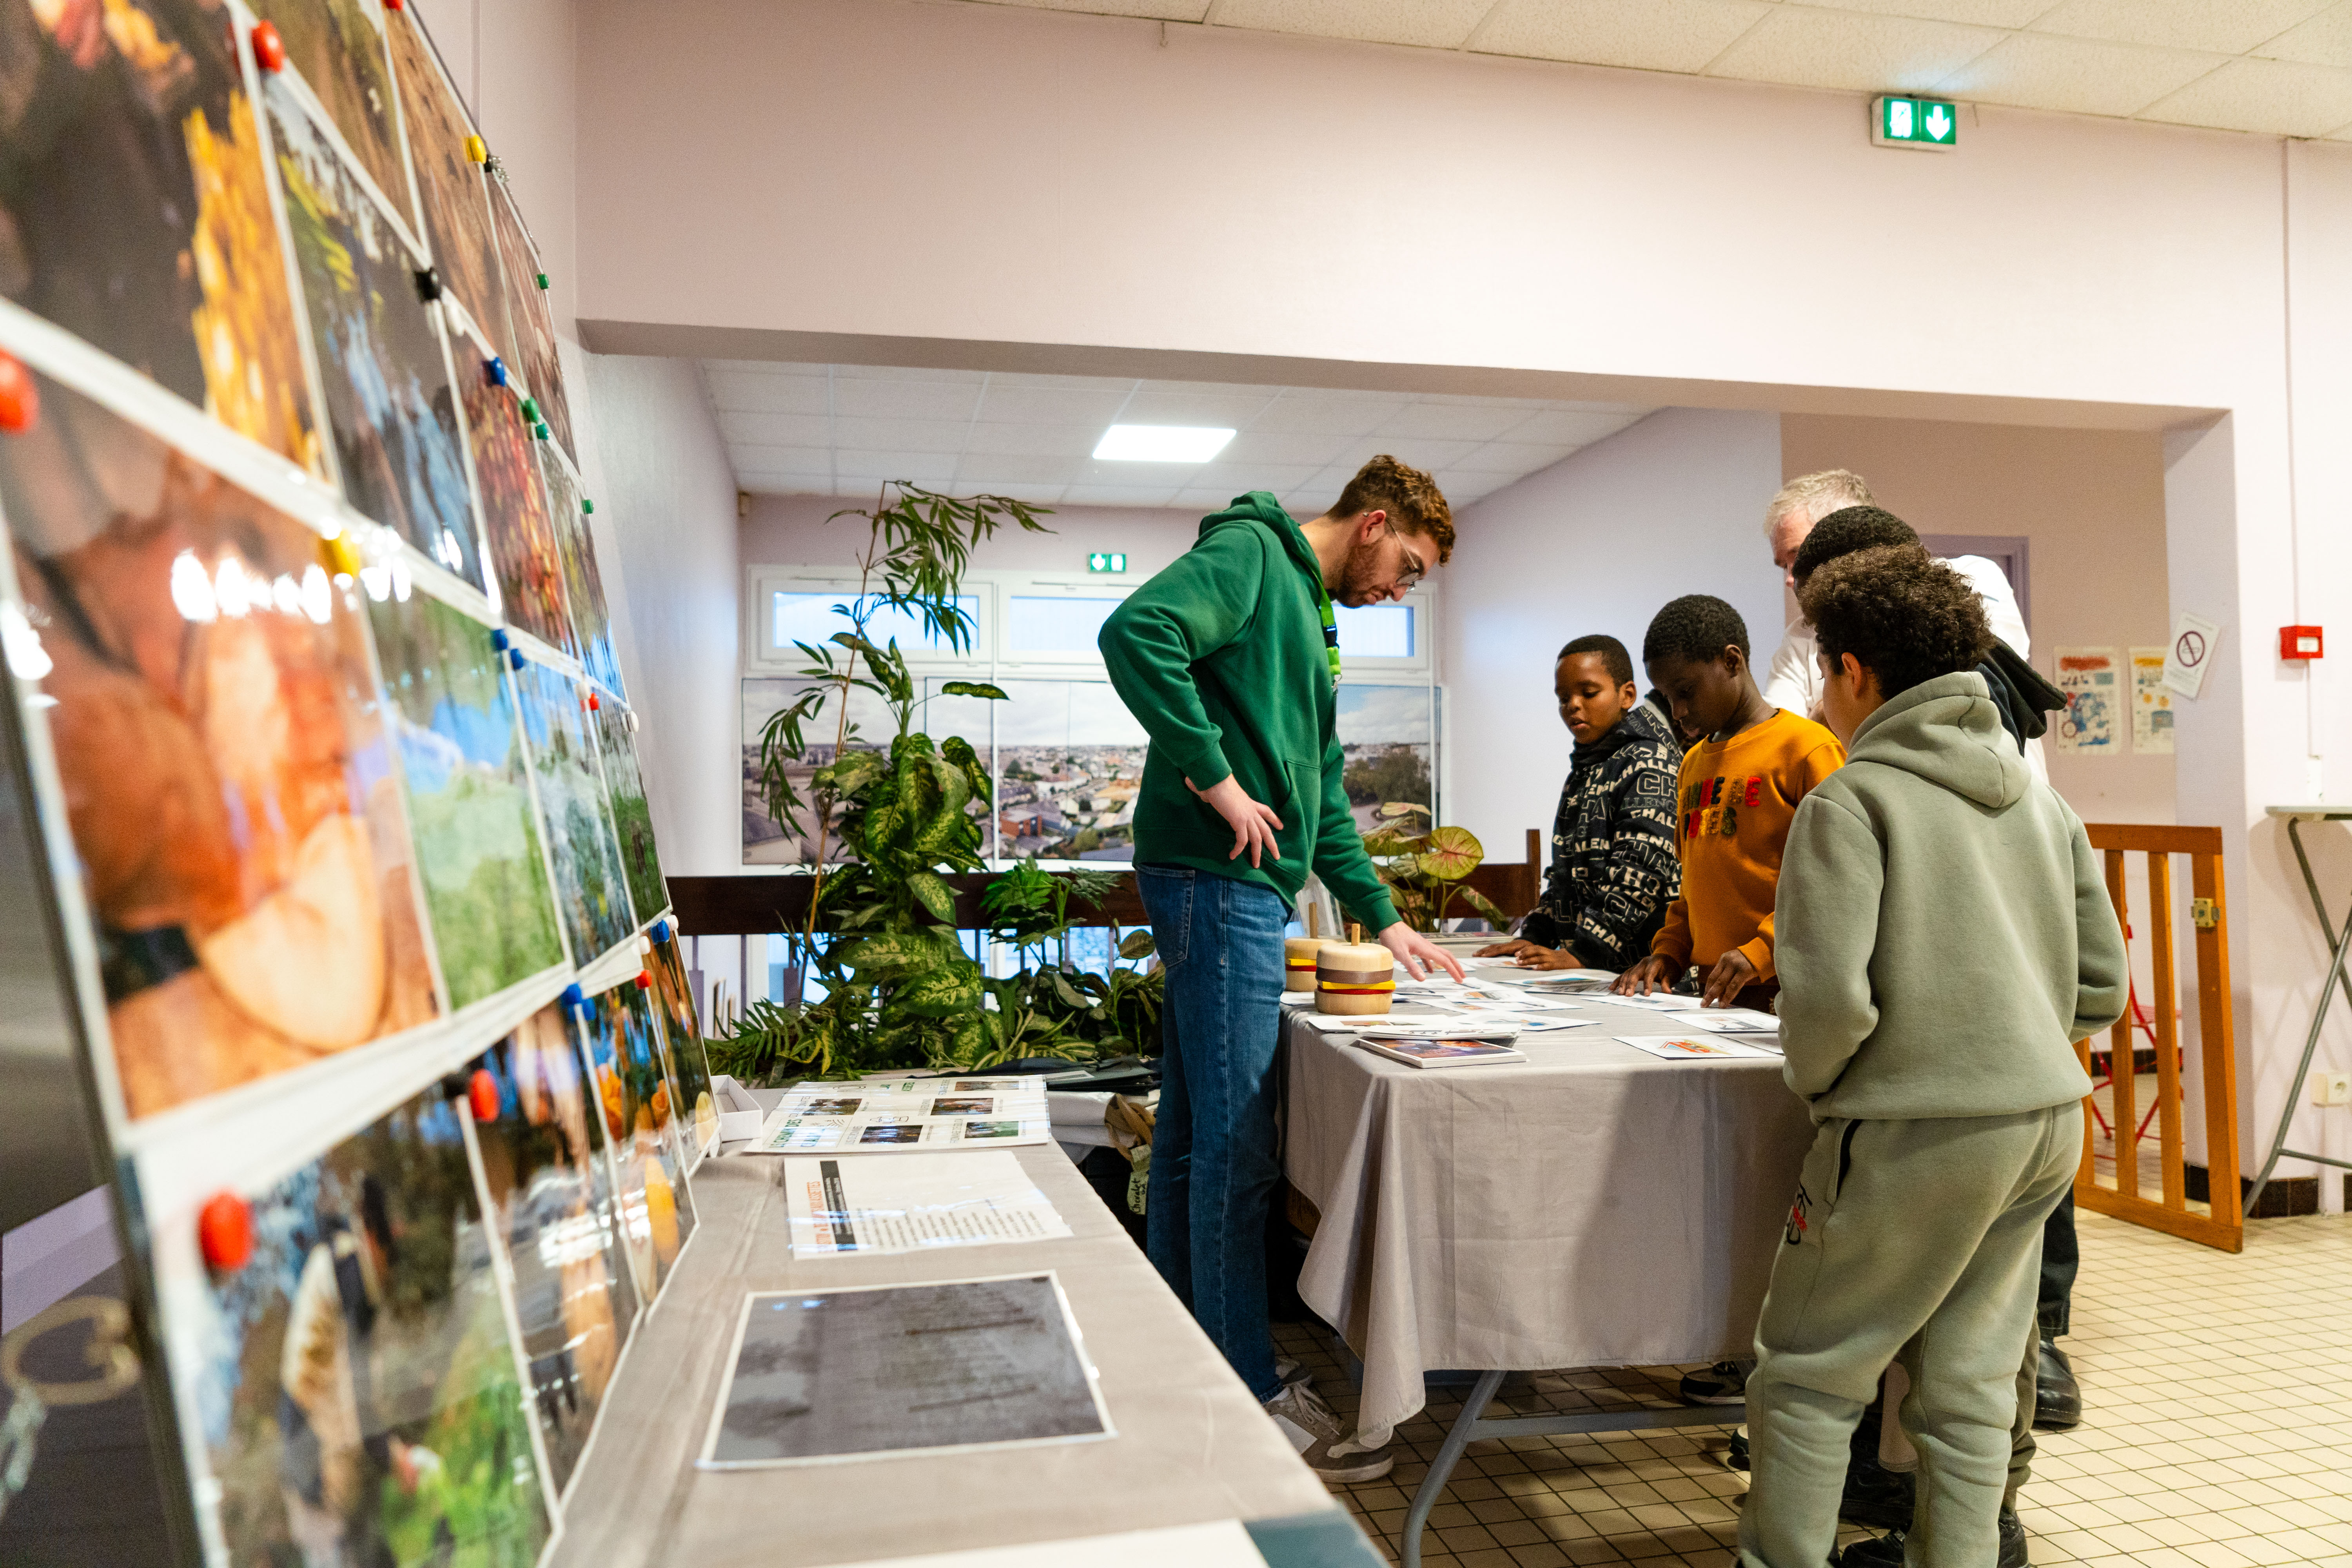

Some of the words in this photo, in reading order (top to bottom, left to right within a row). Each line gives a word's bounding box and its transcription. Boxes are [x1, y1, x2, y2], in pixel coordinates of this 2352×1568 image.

[1616, 759, 1679, 785] HALLE
[1630, 808, 1677, 829] CHAL
[785, 1119, 803, 1127] DES
